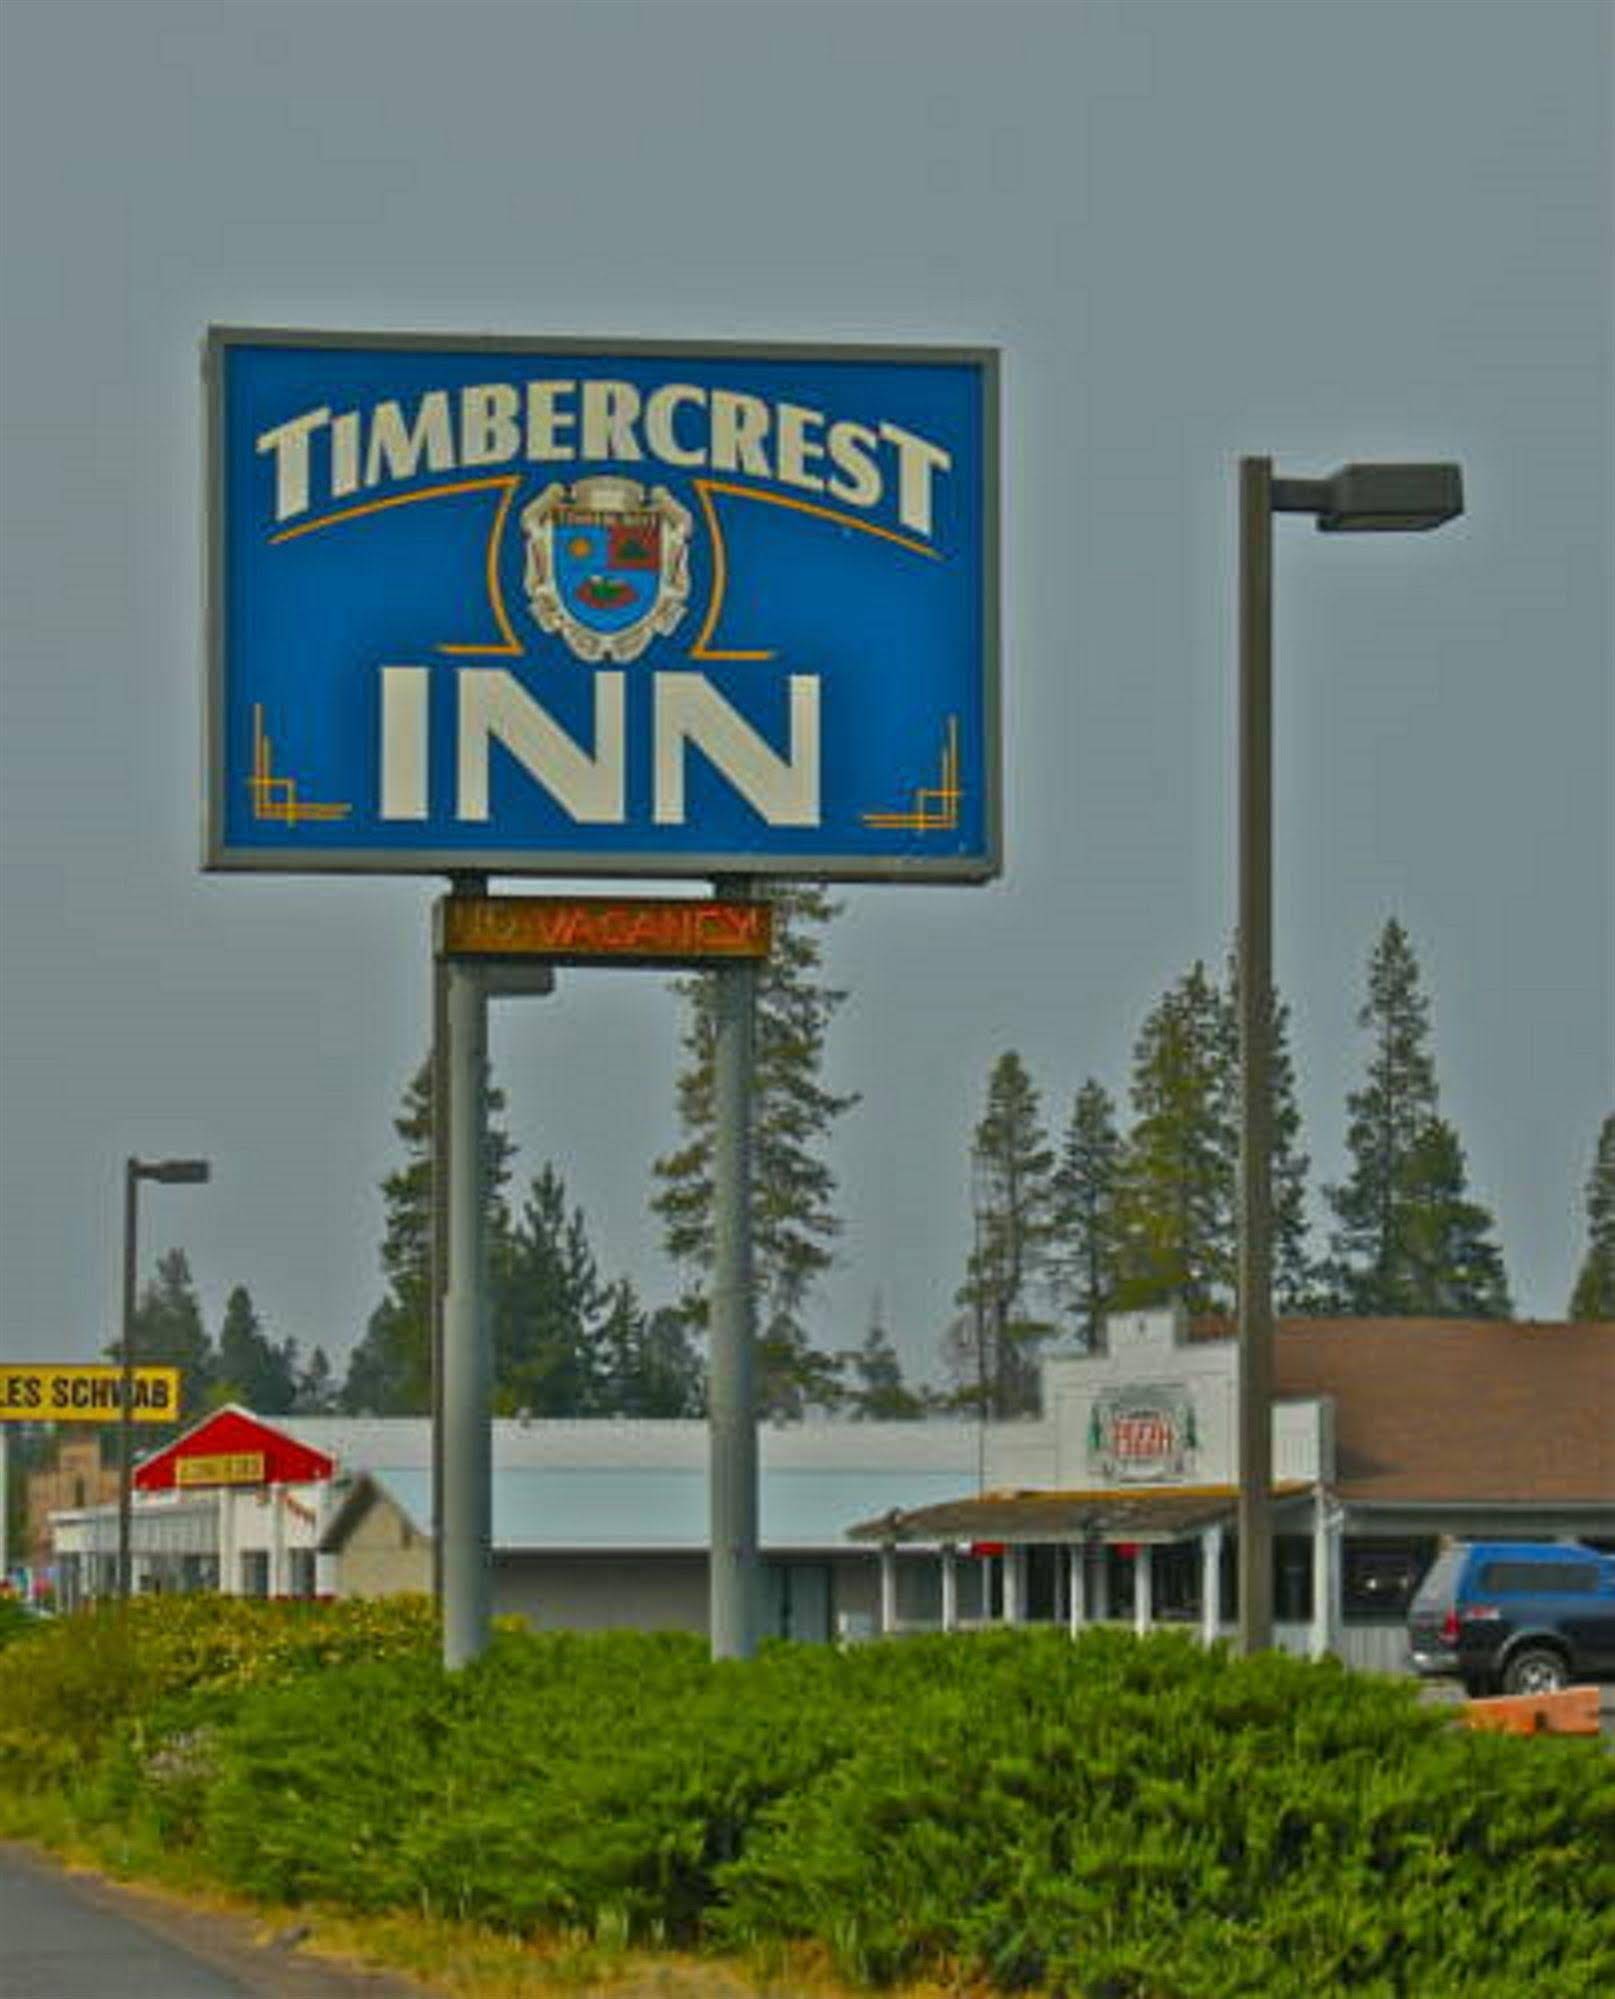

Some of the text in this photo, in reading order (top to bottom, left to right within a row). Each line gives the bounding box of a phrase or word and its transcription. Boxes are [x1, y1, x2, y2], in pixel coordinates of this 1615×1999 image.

[256, 379, 952, 537] TIMBERCREST
[379, 665, 822, 829] INN
[543, 904, 758, 946] VACANCY
[0, 1376, 41, 1408] ES
